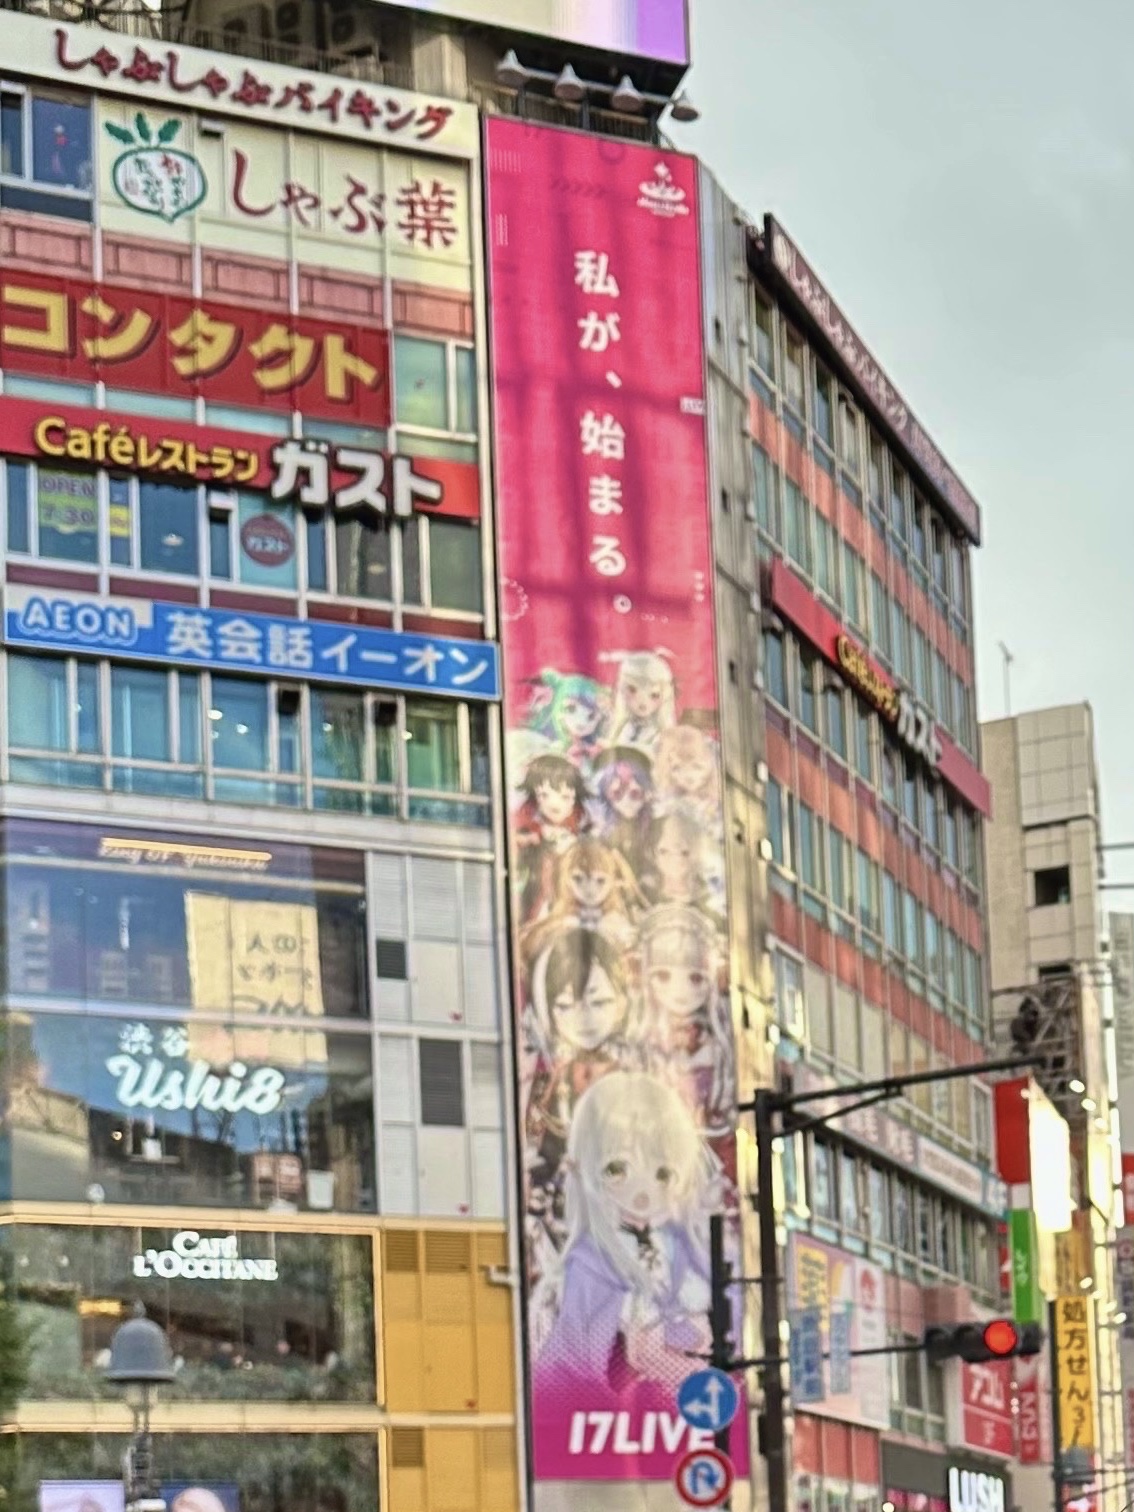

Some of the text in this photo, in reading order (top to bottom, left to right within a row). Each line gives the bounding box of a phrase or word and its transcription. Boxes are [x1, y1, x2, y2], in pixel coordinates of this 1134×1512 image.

[54, 28, 453, 140] しゃぶしゃぶバイキング
[232, 147, 459, 249] しゃぶ葉
[4, 285, 381, 400] コンタクト
[271, 439, 443, 516] ガスト
[573, 250, 634, 614] 私が、始まる。
[22, 598, 488, 685] AEON 英会話イーオン
[106, 1055, 287, 1115] Ushi8
